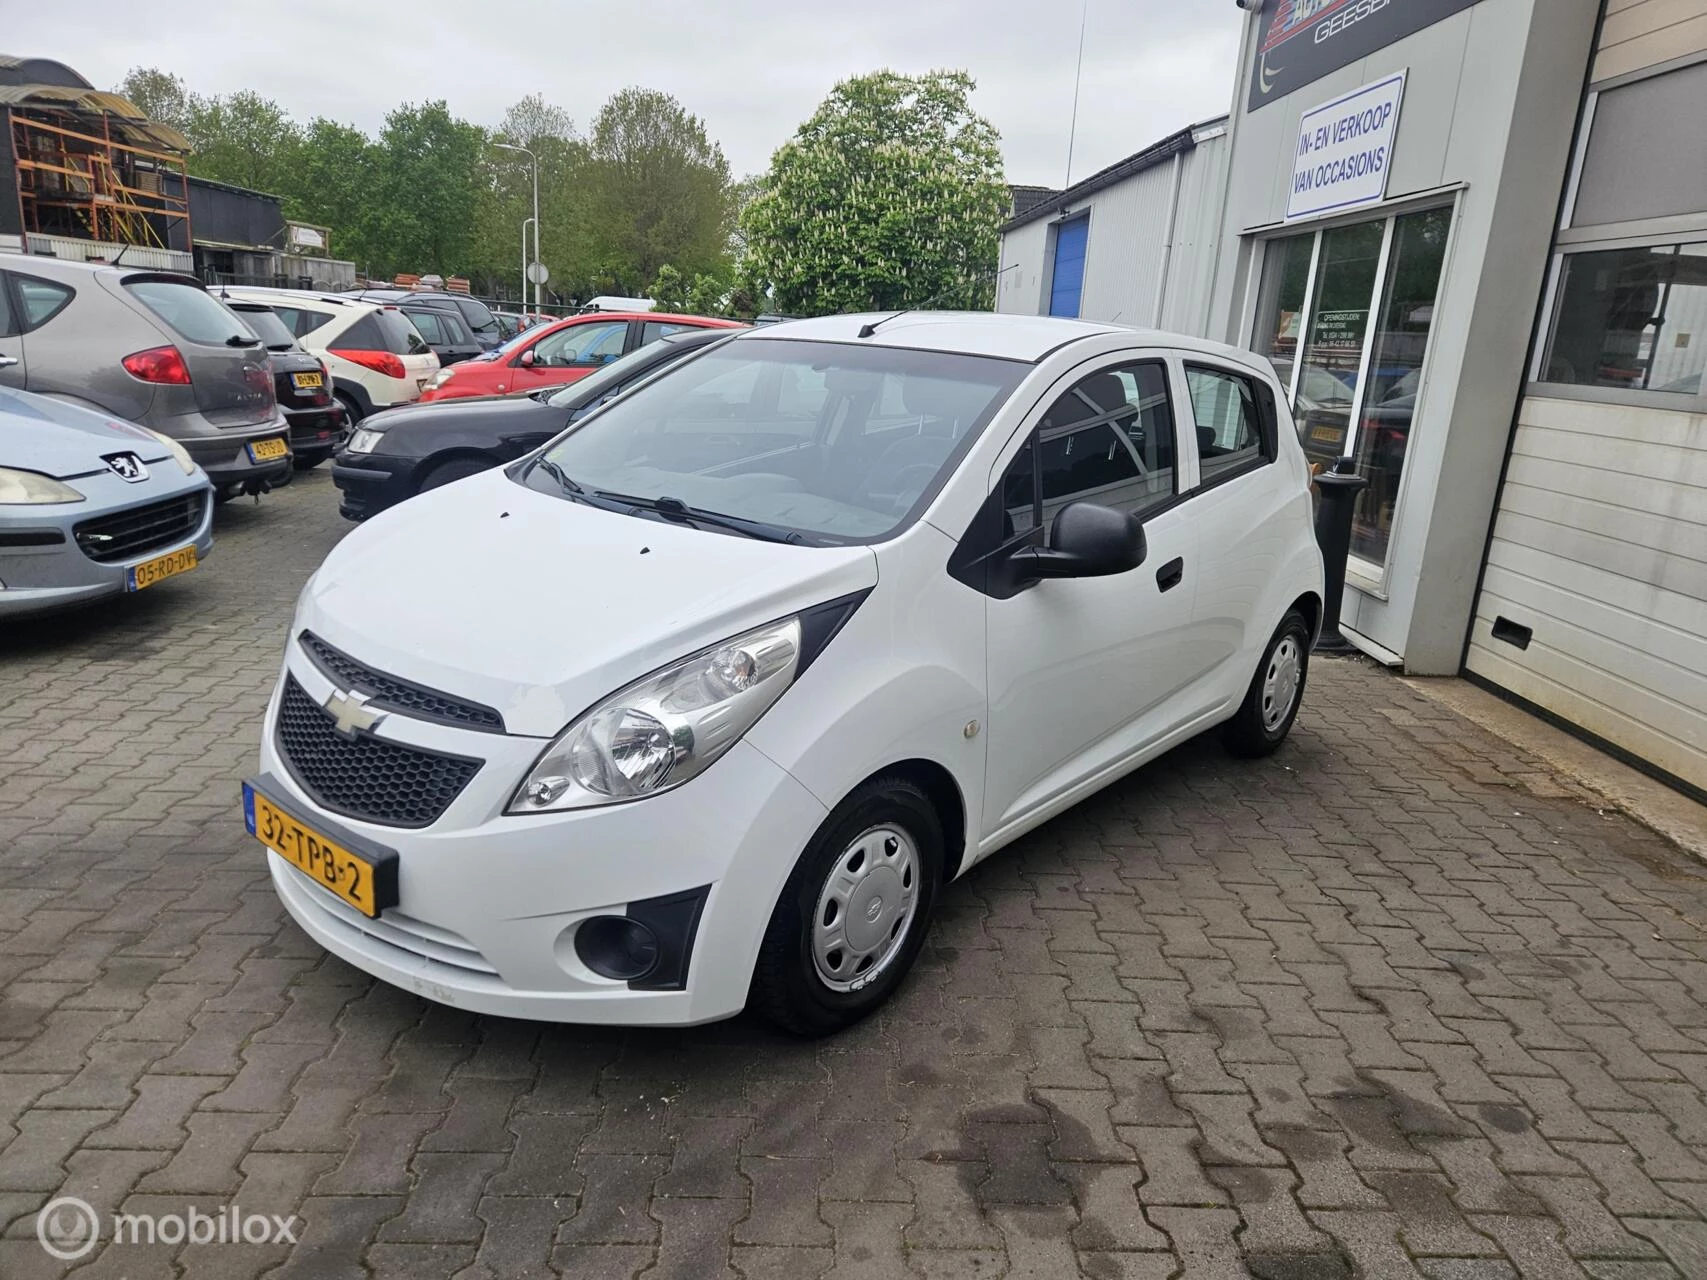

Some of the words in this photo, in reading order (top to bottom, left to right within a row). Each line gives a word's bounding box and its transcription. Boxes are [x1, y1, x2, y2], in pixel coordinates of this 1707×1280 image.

[1314, 0, 1391, 44] GEESB
[1299, 134, 1313, 156] IN-
[1314, 124, 1331, 152] EN
[1332, 102, 1392, 145] VERKOOP
[1294, 169, 1316, 194] VAN
[1315, 146, 1385, 188] OCCASIONS
[137, 549, 193, 585] 05-RD-DV
[261, 804, 361, 902] 32-TPB-2
